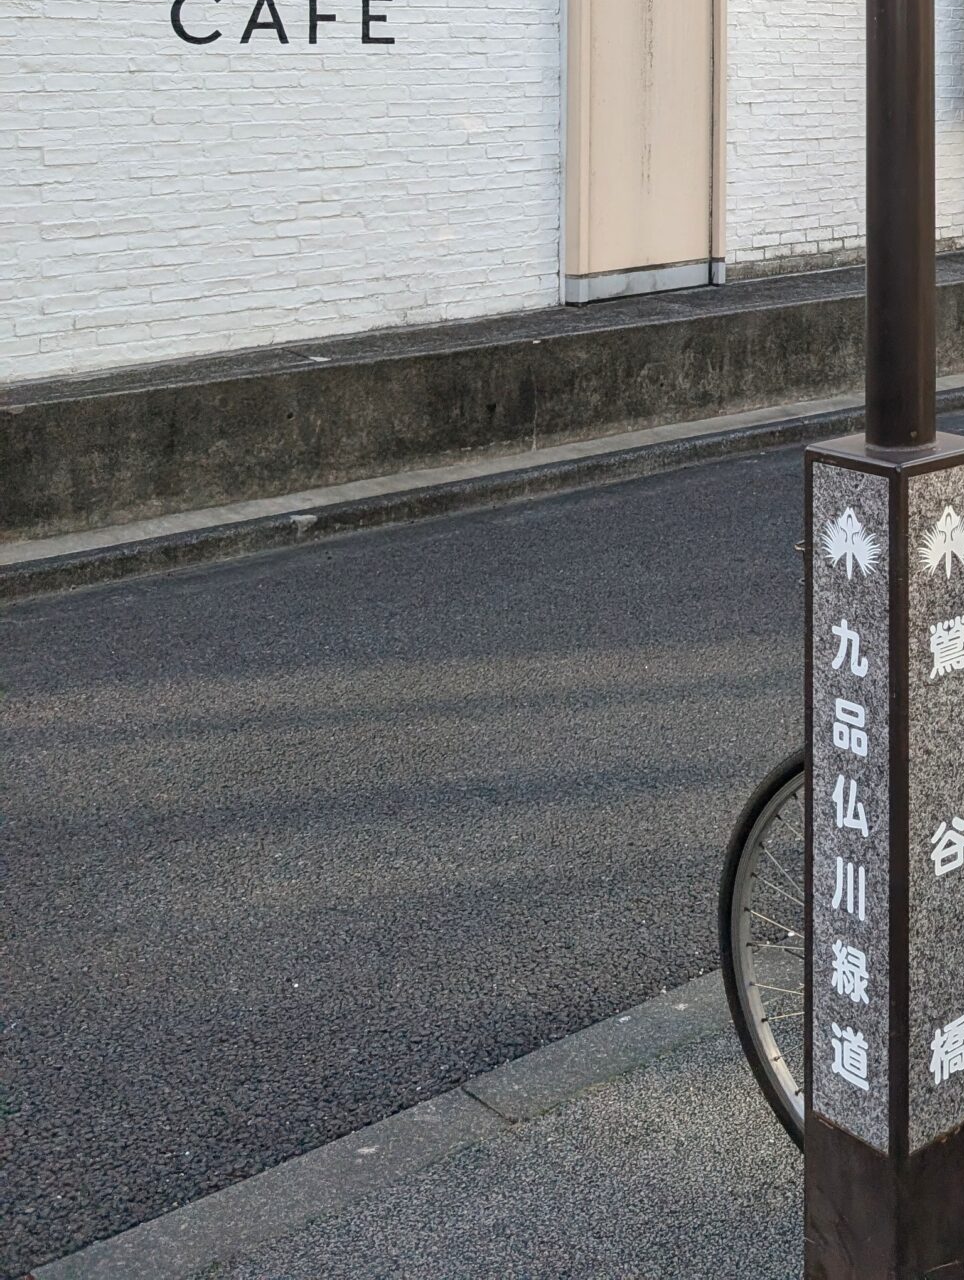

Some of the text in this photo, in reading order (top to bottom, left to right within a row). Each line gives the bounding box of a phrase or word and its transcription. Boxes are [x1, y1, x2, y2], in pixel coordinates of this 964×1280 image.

[831, 619, 869, 1090] 九品仏川緑道
